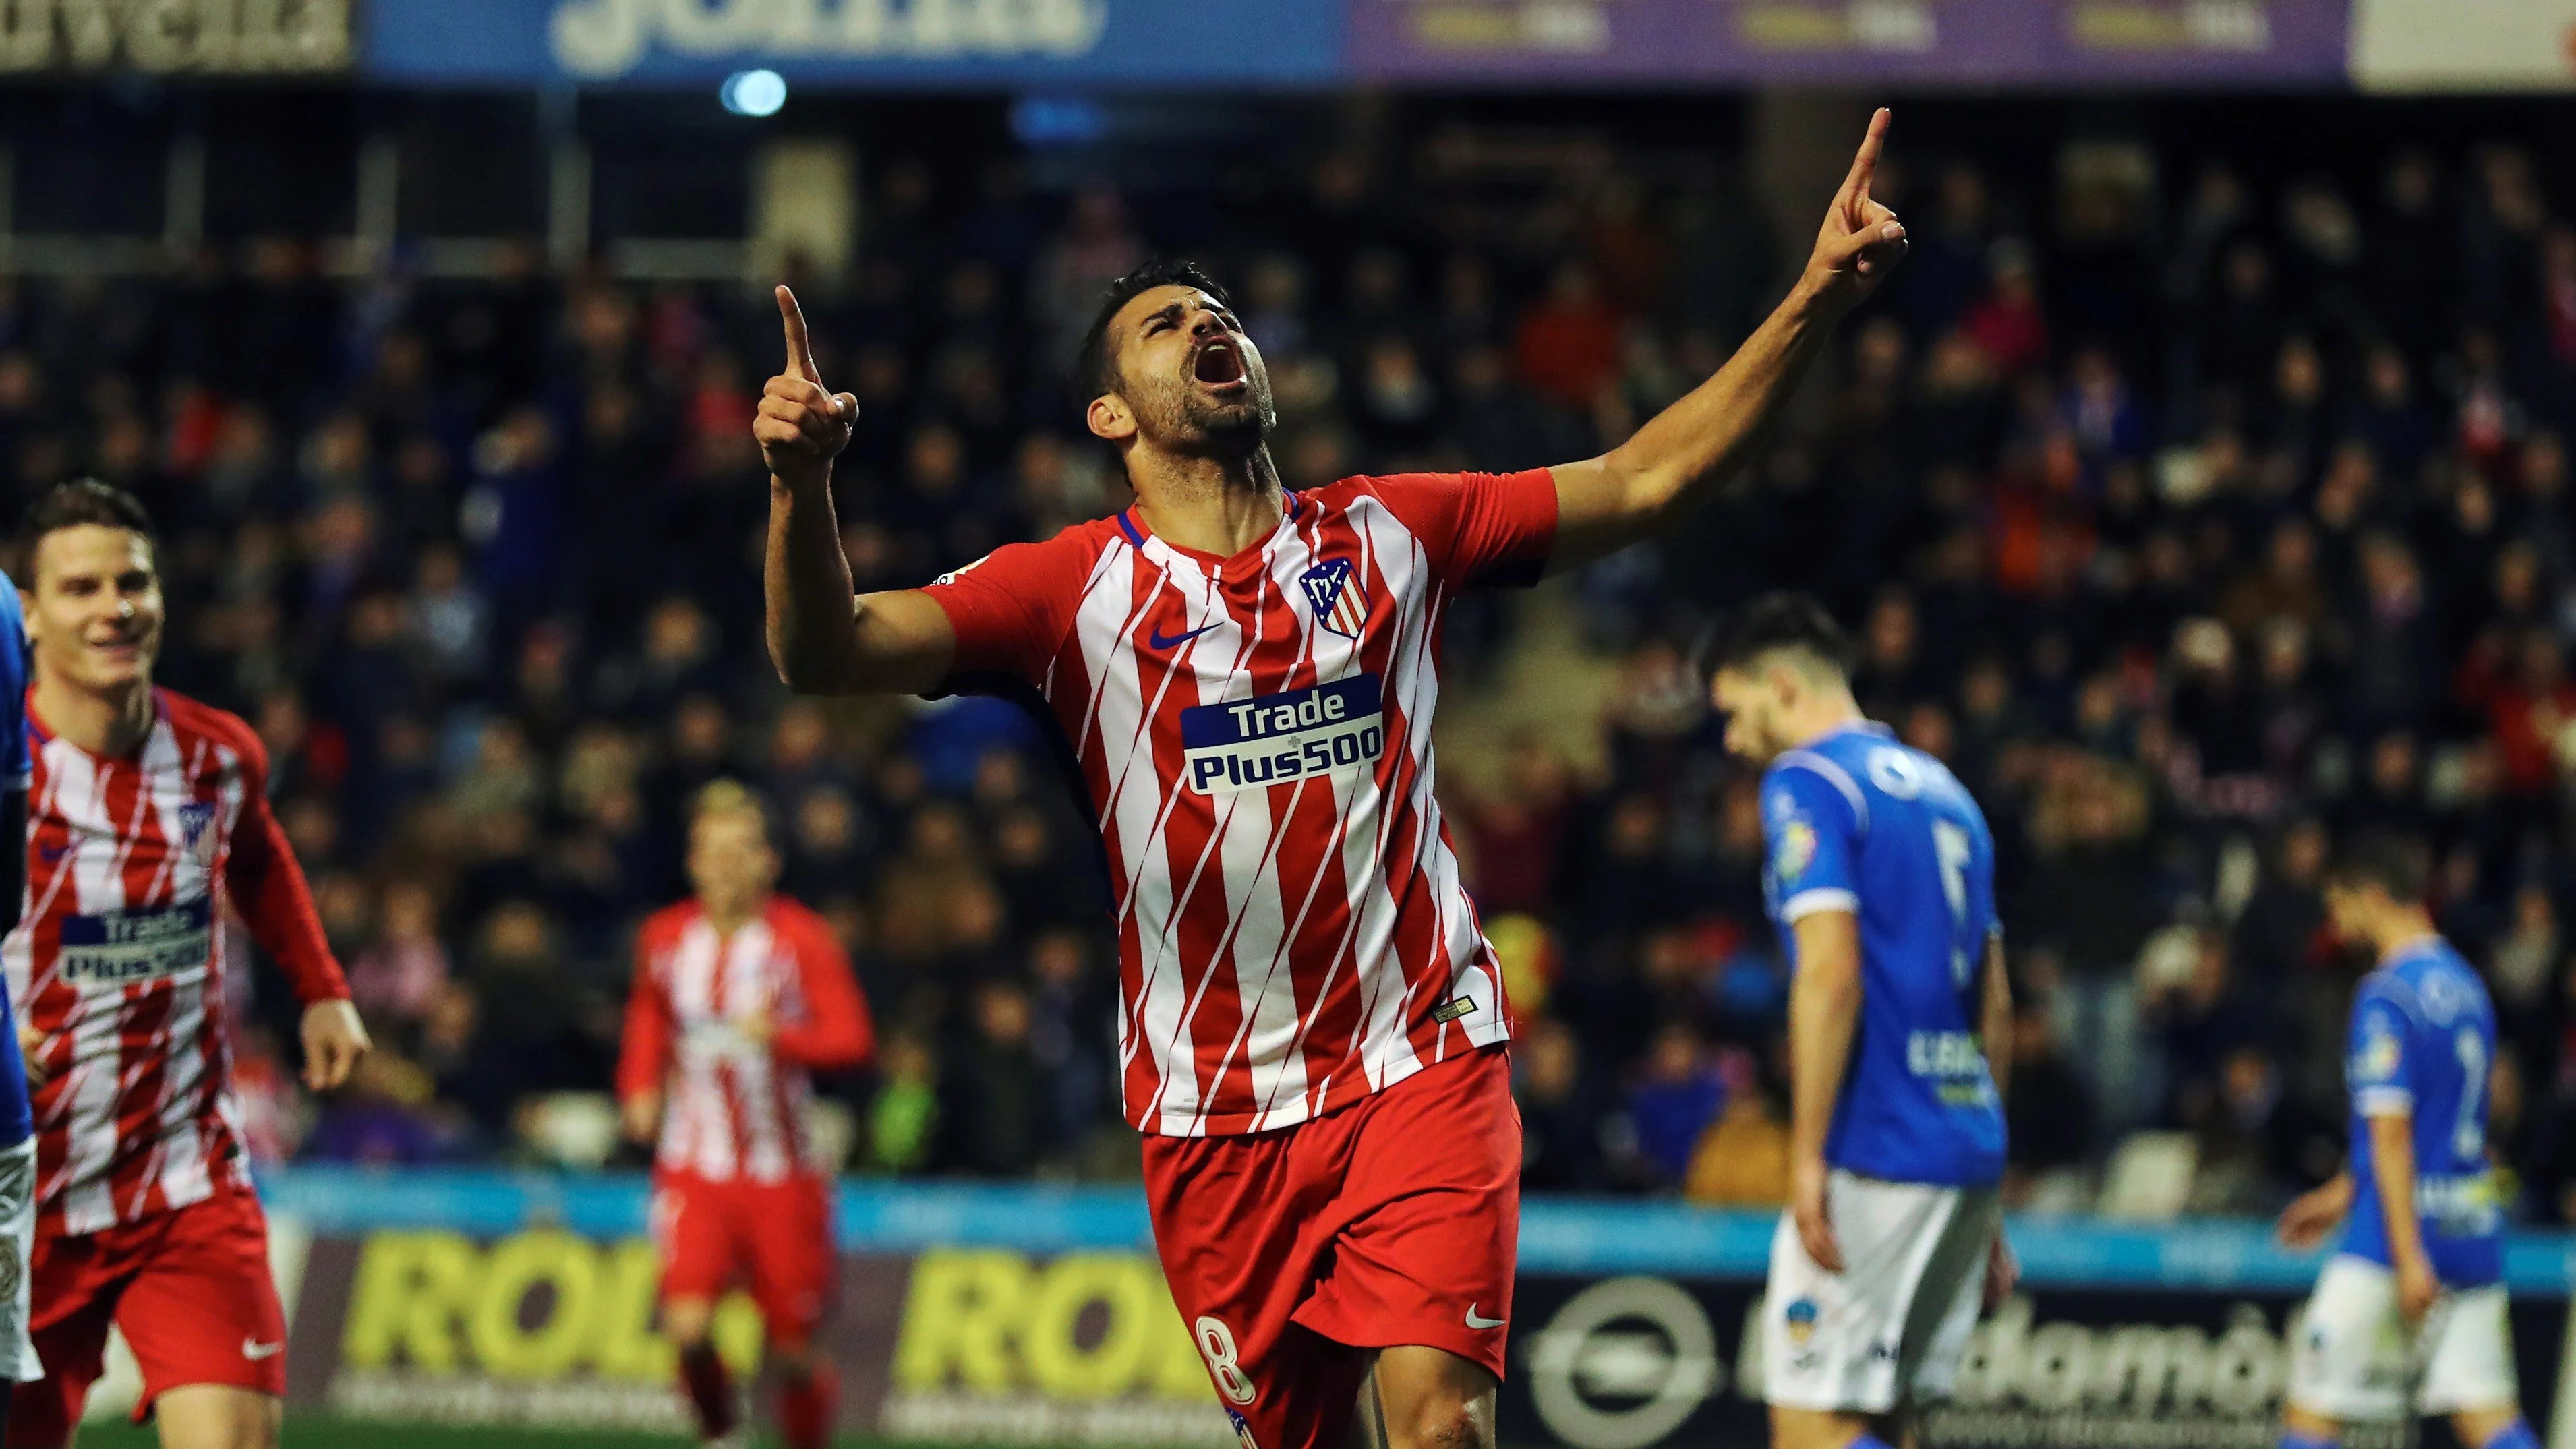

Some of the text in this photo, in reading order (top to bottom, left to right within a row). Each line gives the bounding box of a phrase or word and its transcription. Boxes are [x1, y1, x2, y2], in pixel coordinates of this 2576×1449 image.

[1227, 689, 1346, 737] Trade
[1192, 725, 1381, 790] Plus500
[102, 908, 194, 943] Trade
[1195, 1315, 1257, 1407] 8
